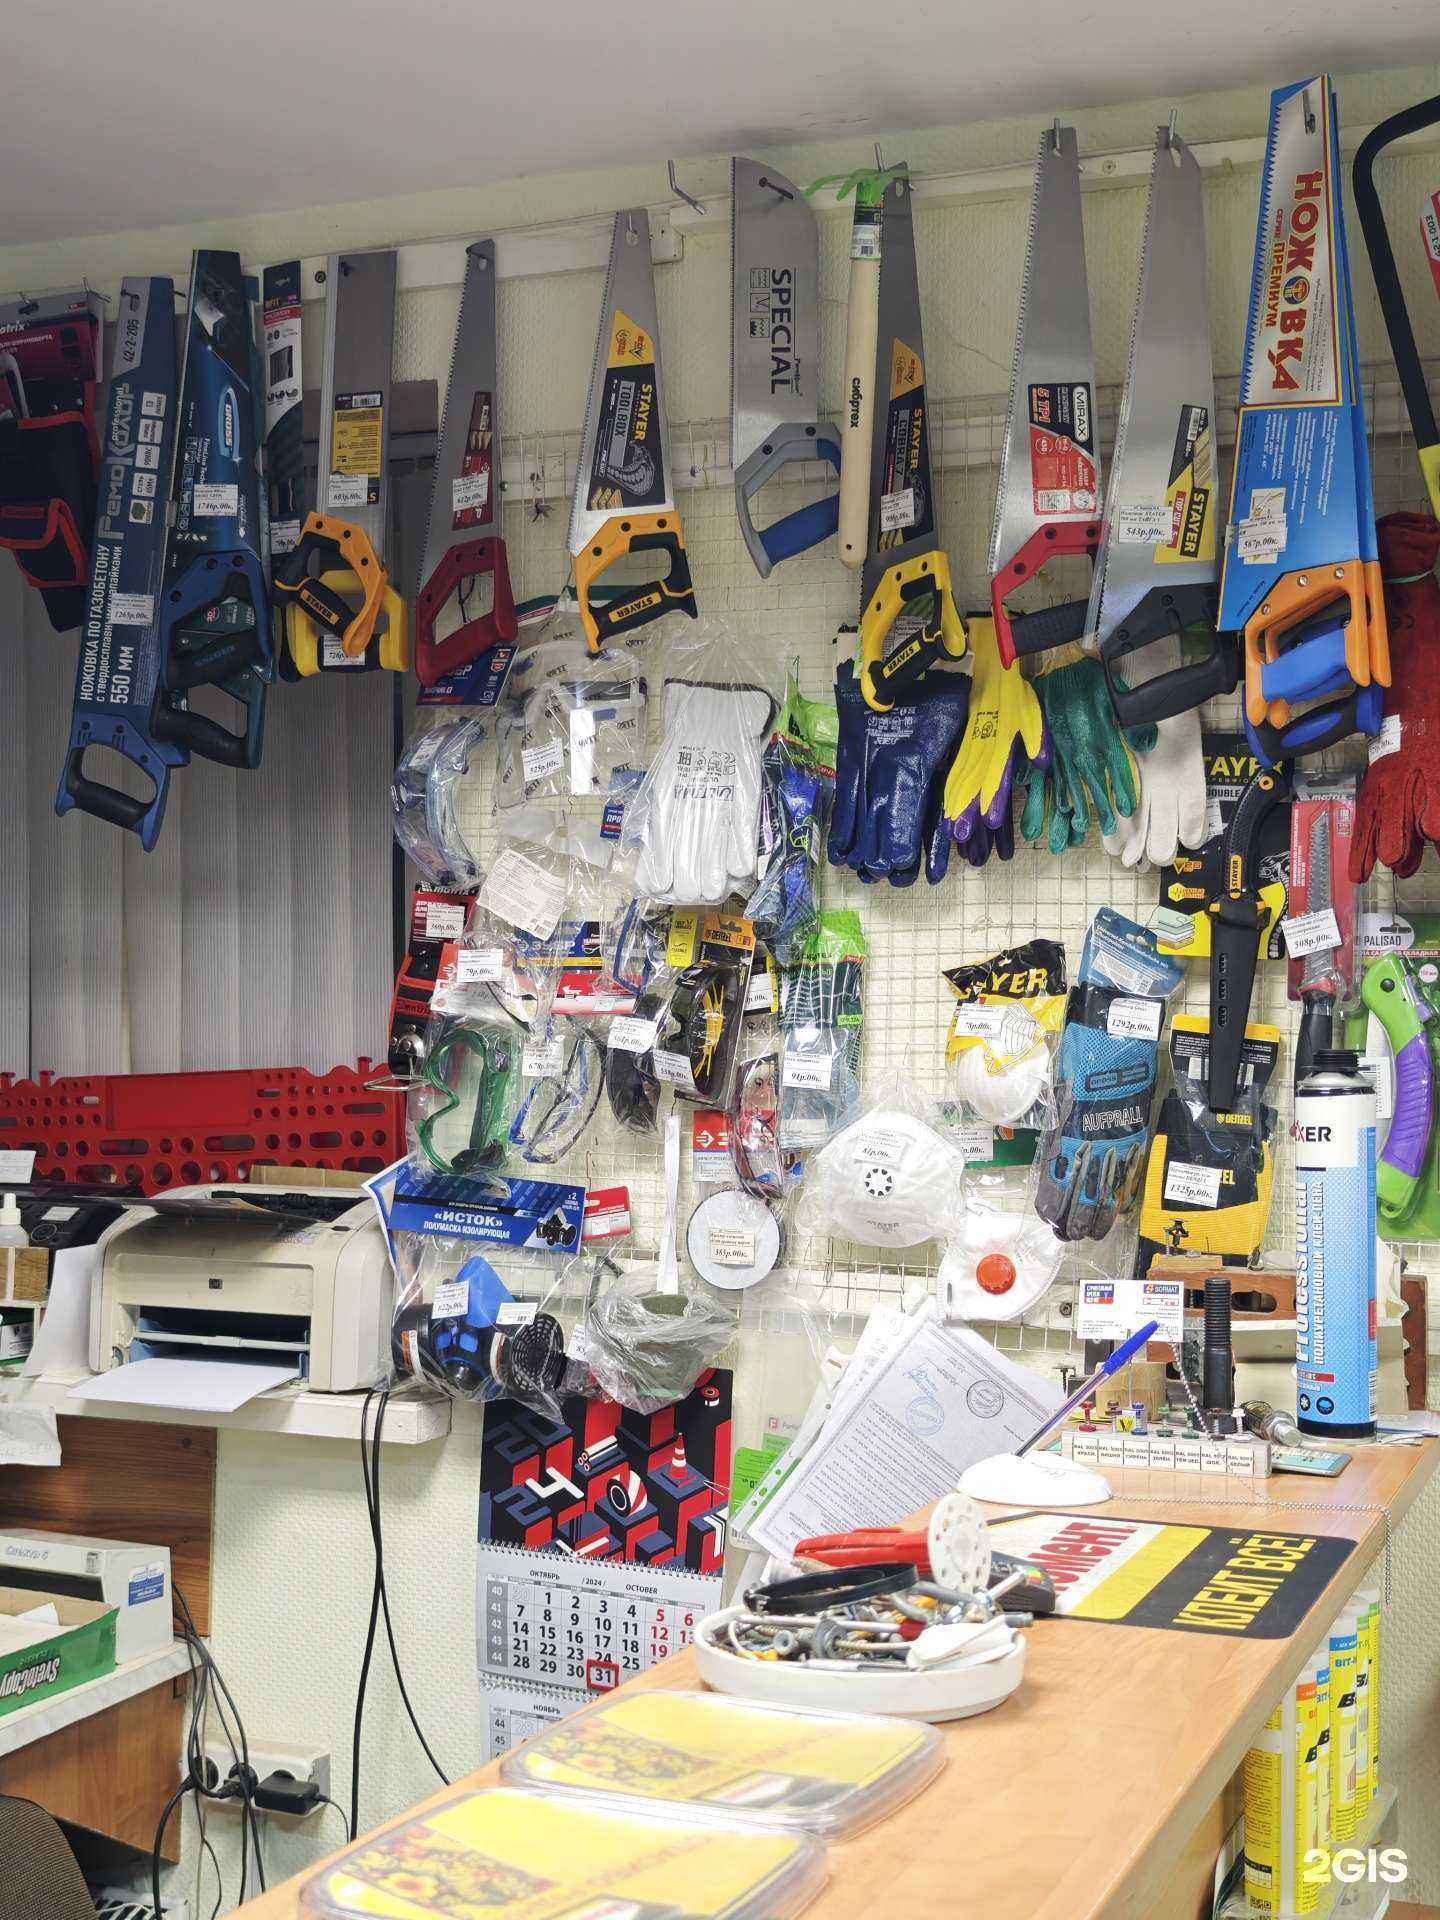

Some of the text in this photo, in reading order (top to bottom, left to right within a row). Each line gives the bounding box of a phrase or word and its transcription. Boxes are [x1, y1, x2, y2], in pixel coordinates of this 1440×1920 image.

[1264, 240, 1286, 328] ПРЕМИУМ
[771, 268, 791, 394] SPECIAL
[111, 387, 124, 441] professional
[614, 385, 633, 438] TOOLBOX
[634, 383, 653, 441] STAYER
[850, 377, 863, 428] сибртех
[1075, 389, 1089, 437] MIRAX
[910, 407, 923, 469] STAYER
[1184, 492, 1205, 553] STAYER
[306, 592, 335, 619] STAYER
[616, 596, 653, 619] STAYER
[79, 544, 111, 702] НОЖОВКА ПО ГАЗОБЕТОНУ
[887, 645, 916, 673] STAYER
[109, 674, 131, 704] 550
[1230, 859, 1240, 888] STAYER
[1363, 936, 1402, 946] PALISAD
[1082, 1105, 1144, 1132] AUFPRALL
[1224, 1112, 1253, 1126] DENZEL
[423, 1221, 510, 1239] ПОЛУМАСКА ИЗОЛИРУЮЩАЯ
[434, 1210, 503, 1227] «ИСТОК»
[1311, 1181, 1325, 1366] ПОЛИУРЕТАНОВЫЙ КЛЕЙ-ПЕНА
[529, 1569, 561, 1580] ОКТЯБРЬ
[625, 1583, 658, 1595] OCTOBER
[516, 1605, 525, 1617] 7
[543, 1609, 552, 1622] 8
[570, 1613, 580, 1626] 9
[594, 1617, 611, 1631] 10
[622, 1621, 639, 1636] 11
[651, 1626, 669, 1641] 12
[545, 1592, 552, 1605] 1
[571, 1596, 580, 1609] 2
[599, 1600, 608, 1613] 3
[627, 1604, 637, 1618] 4
[656, 1608, 665, 1622] 5
[684, 1613, 694, 1626] 6
[512, 1621, 529, 1635] 14
[539, 1626, 556, 1640] 15
[566, 1630, 584, 1644] 16
[594, 1634, 611, 1648] 17
[622, 1639, 639, 1653] 18
[651, 1644, 668, 1658] 19
[513, 1638, 529, 1652] 21
[539, 1643, 557, 1656] 22
[566, 1647, 584, 1661] 23
[622, 1656, 640, 1671] 25
[513, 1655, 530, 1669] 28
[539, 1659, 557, 1673] 29
[566, 1664, 584, 1678] 30
[595, 1669, 612, 1683] 31
[494, 1719, 505, 1729] 44
[533, 1704, 561, 1715] НОЯБРЬ
[494, 1735, 505, 1746] 45
